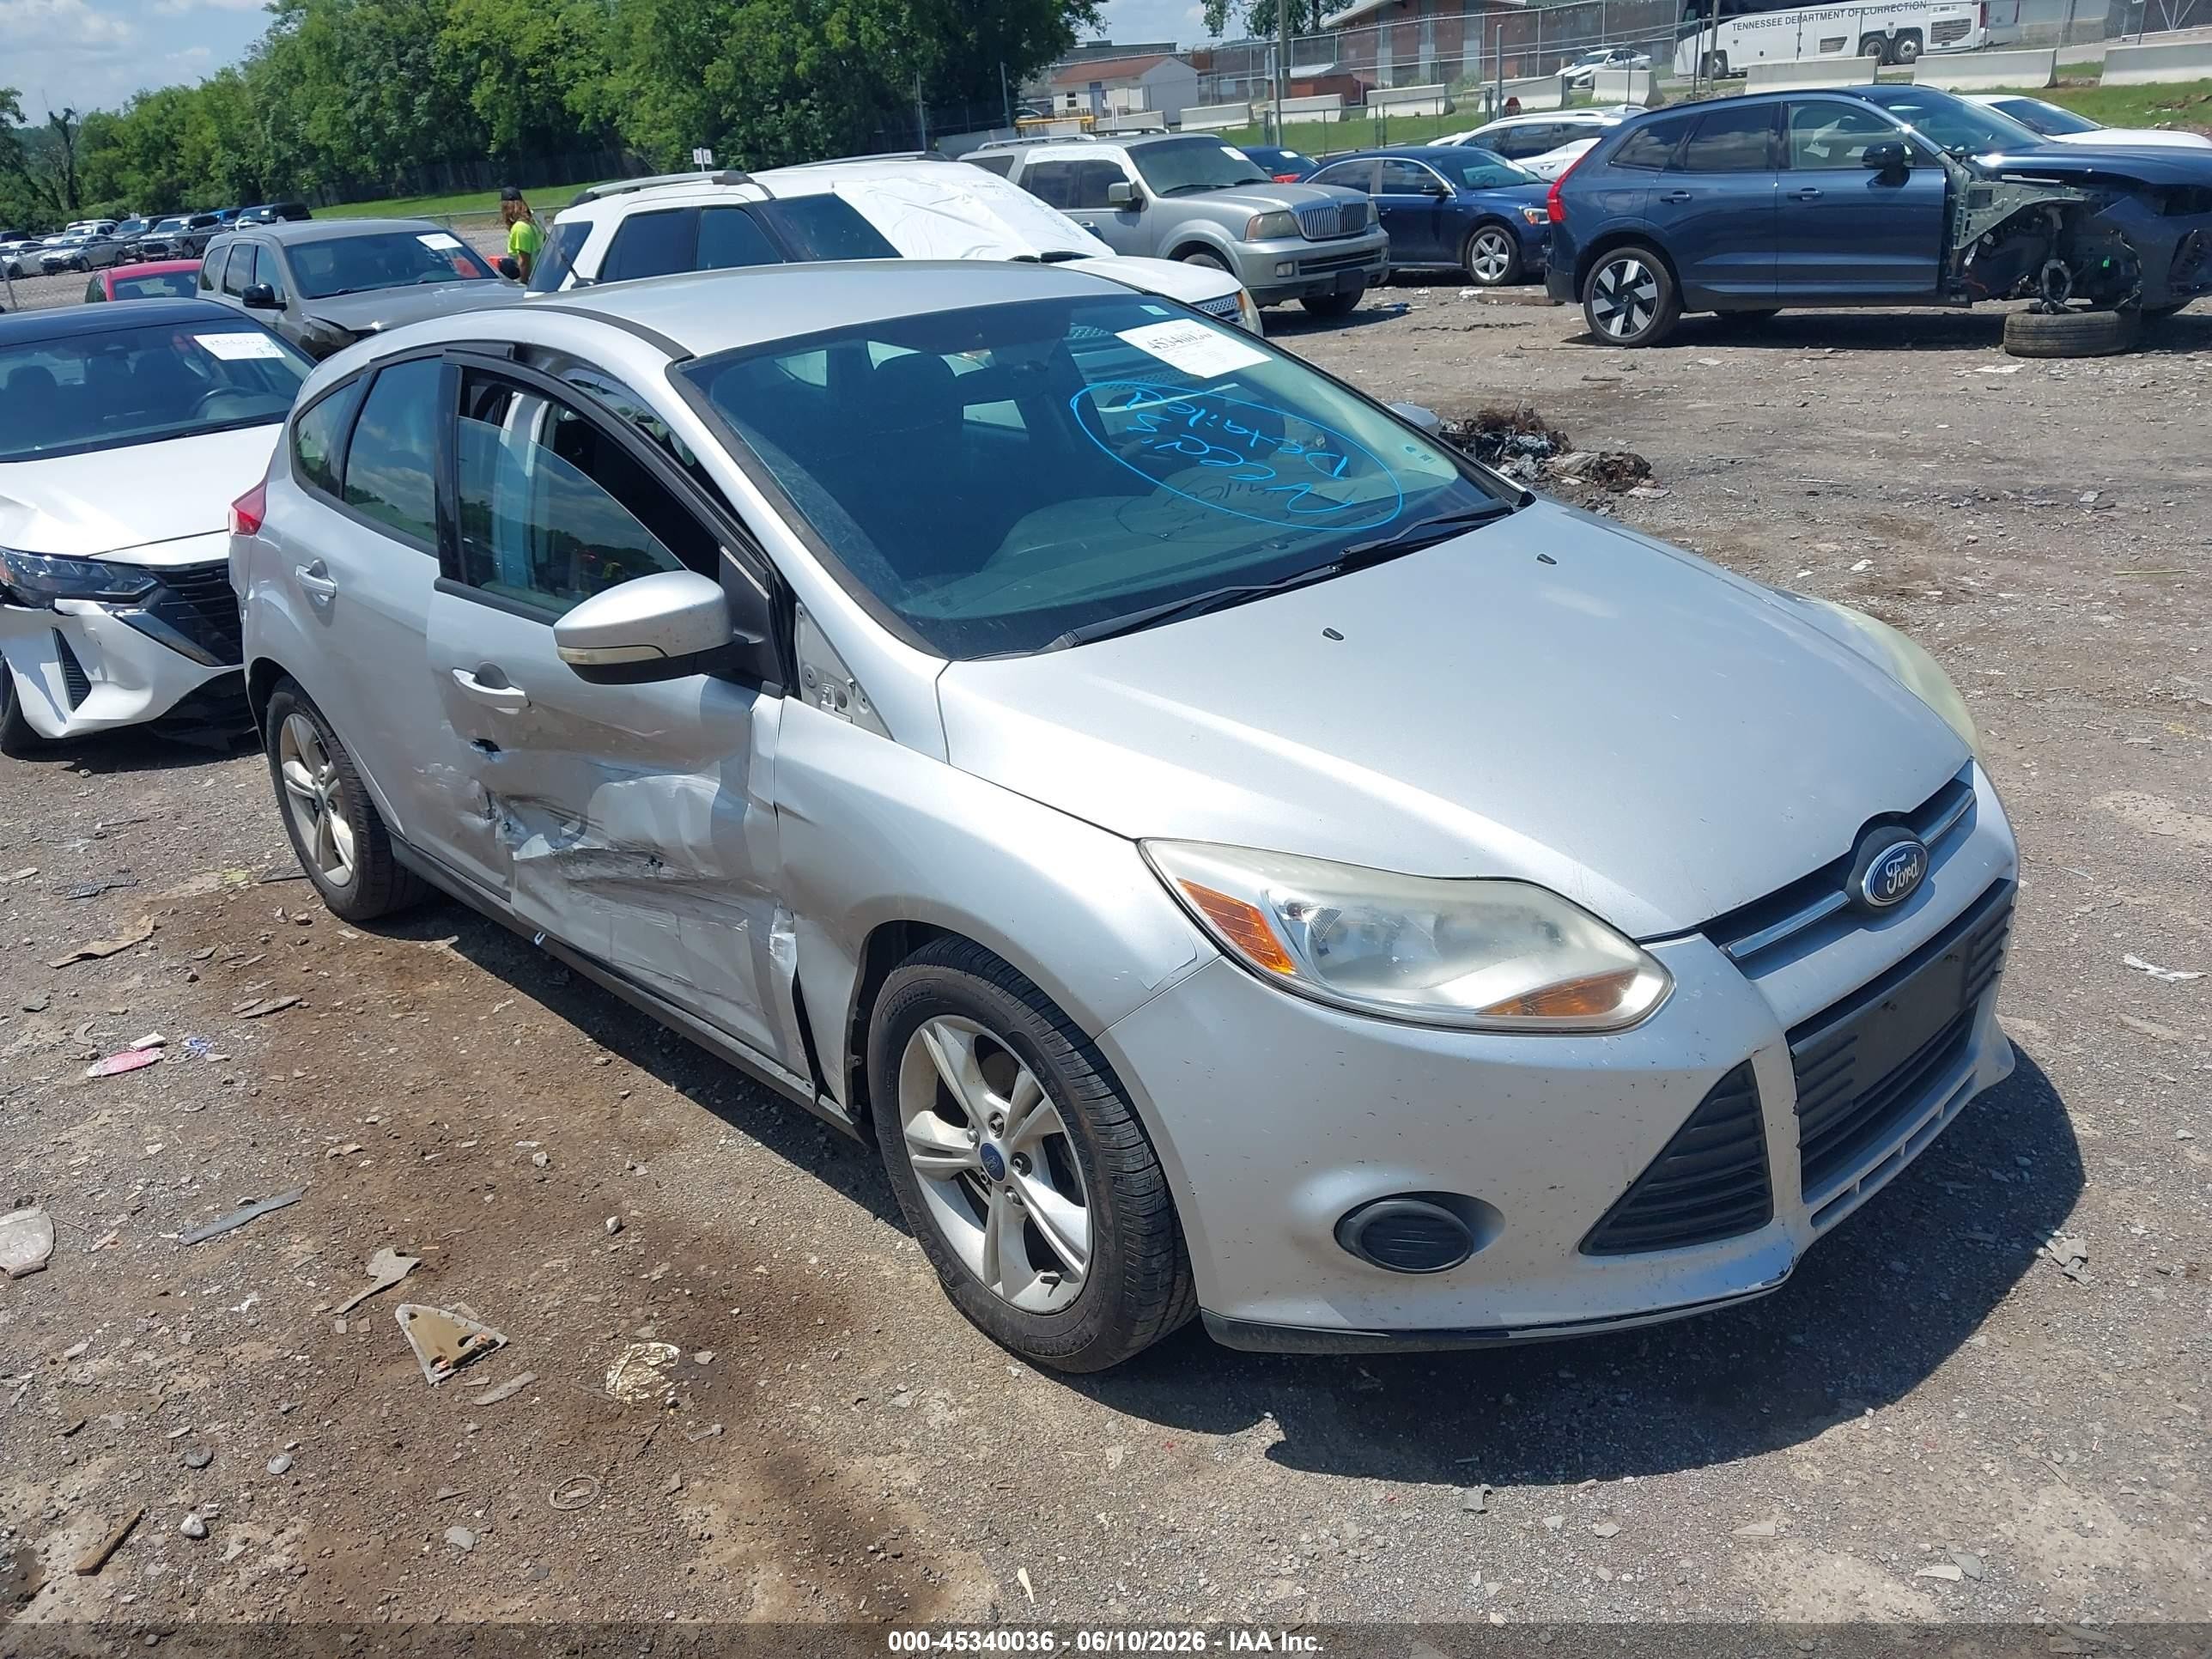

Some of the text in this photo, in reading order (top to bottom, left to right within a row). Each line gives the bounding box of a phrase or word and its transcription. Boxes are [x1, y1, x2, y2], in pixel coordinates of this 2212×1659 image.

[1732, 1, 1928, 31] TENNESSEE DEPARTMENT OF CORRECTION
[1886, 853, 1919, 895] Ford
